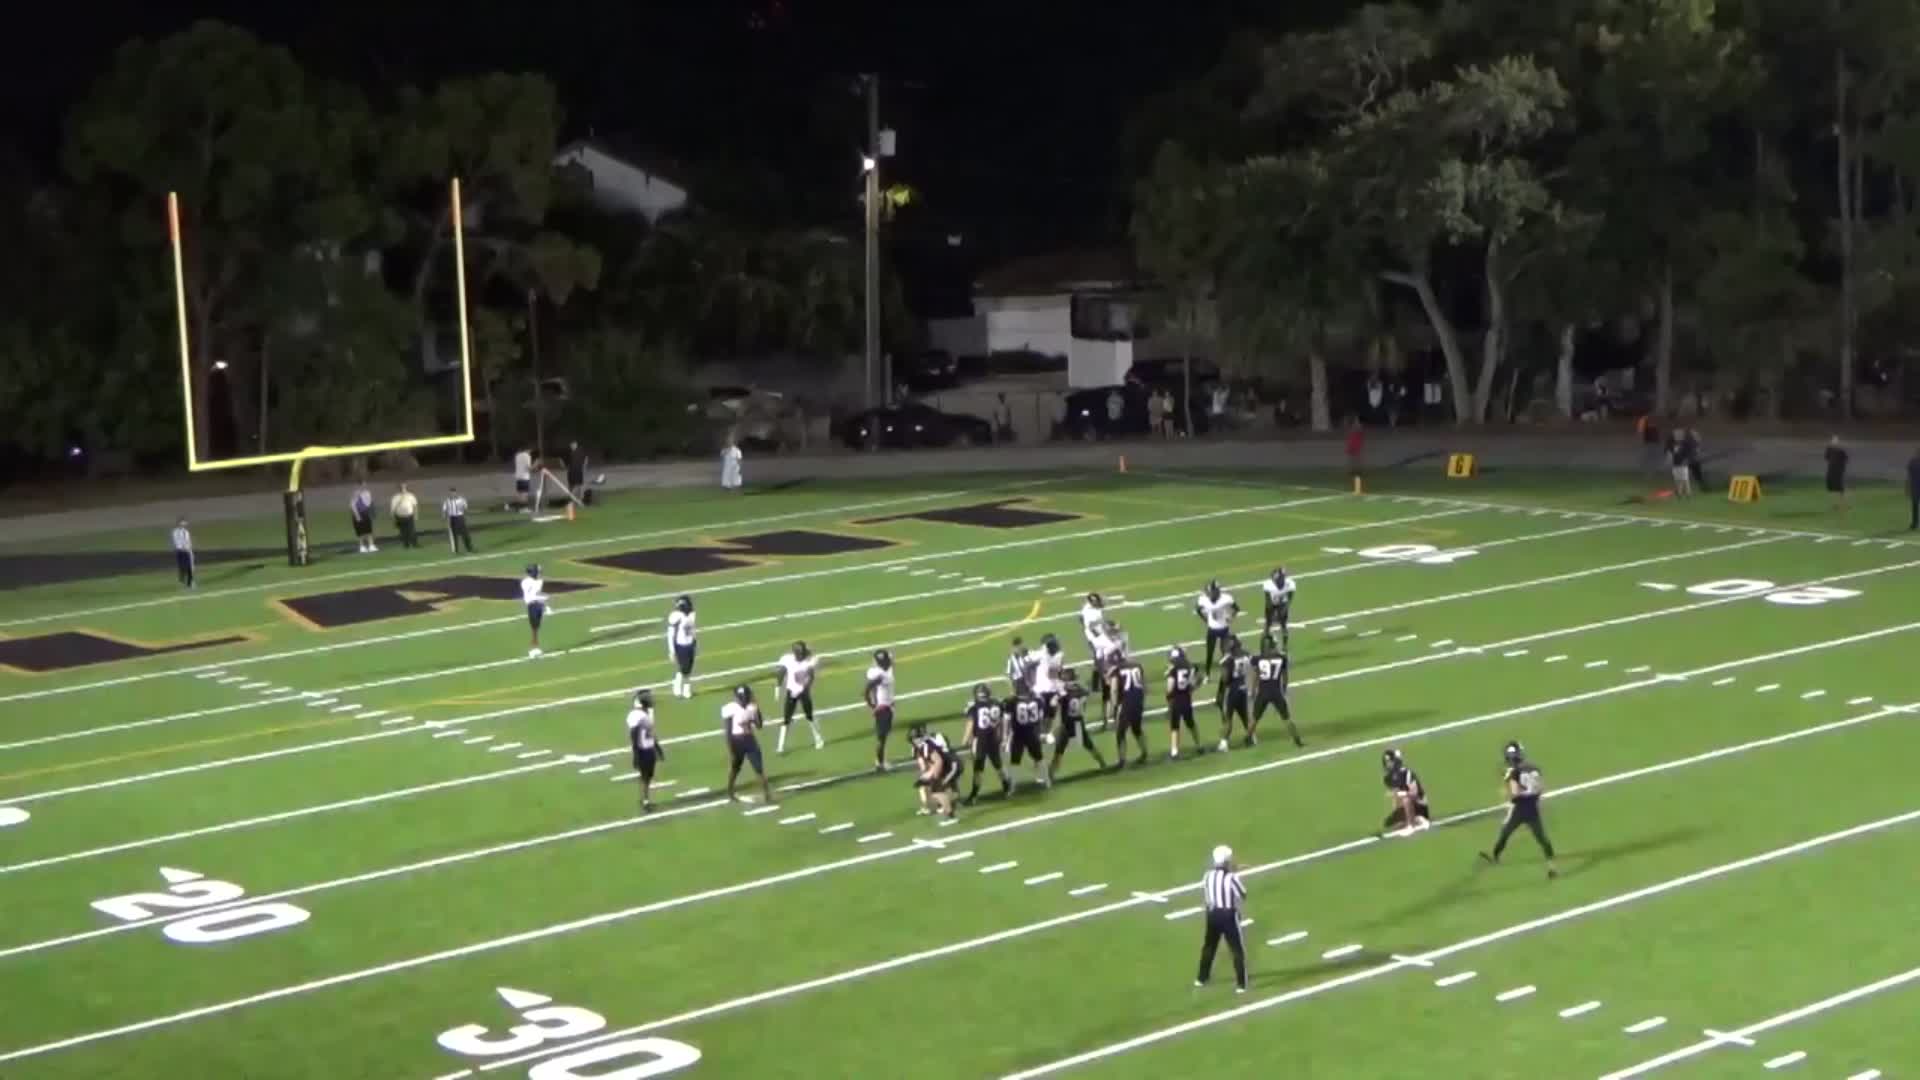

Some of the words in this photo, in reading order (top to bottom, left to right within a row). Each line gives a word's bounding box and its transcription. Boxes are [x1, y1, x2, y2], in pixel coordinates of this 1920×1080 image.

[1685, 579, 1864, 605] 20
[1119, 668, 1143, 692] 70
[1257, 658, 1284, 681] 97
[90, 880, 312, 943] 20
[437, 1006, 702, 1080] 30
